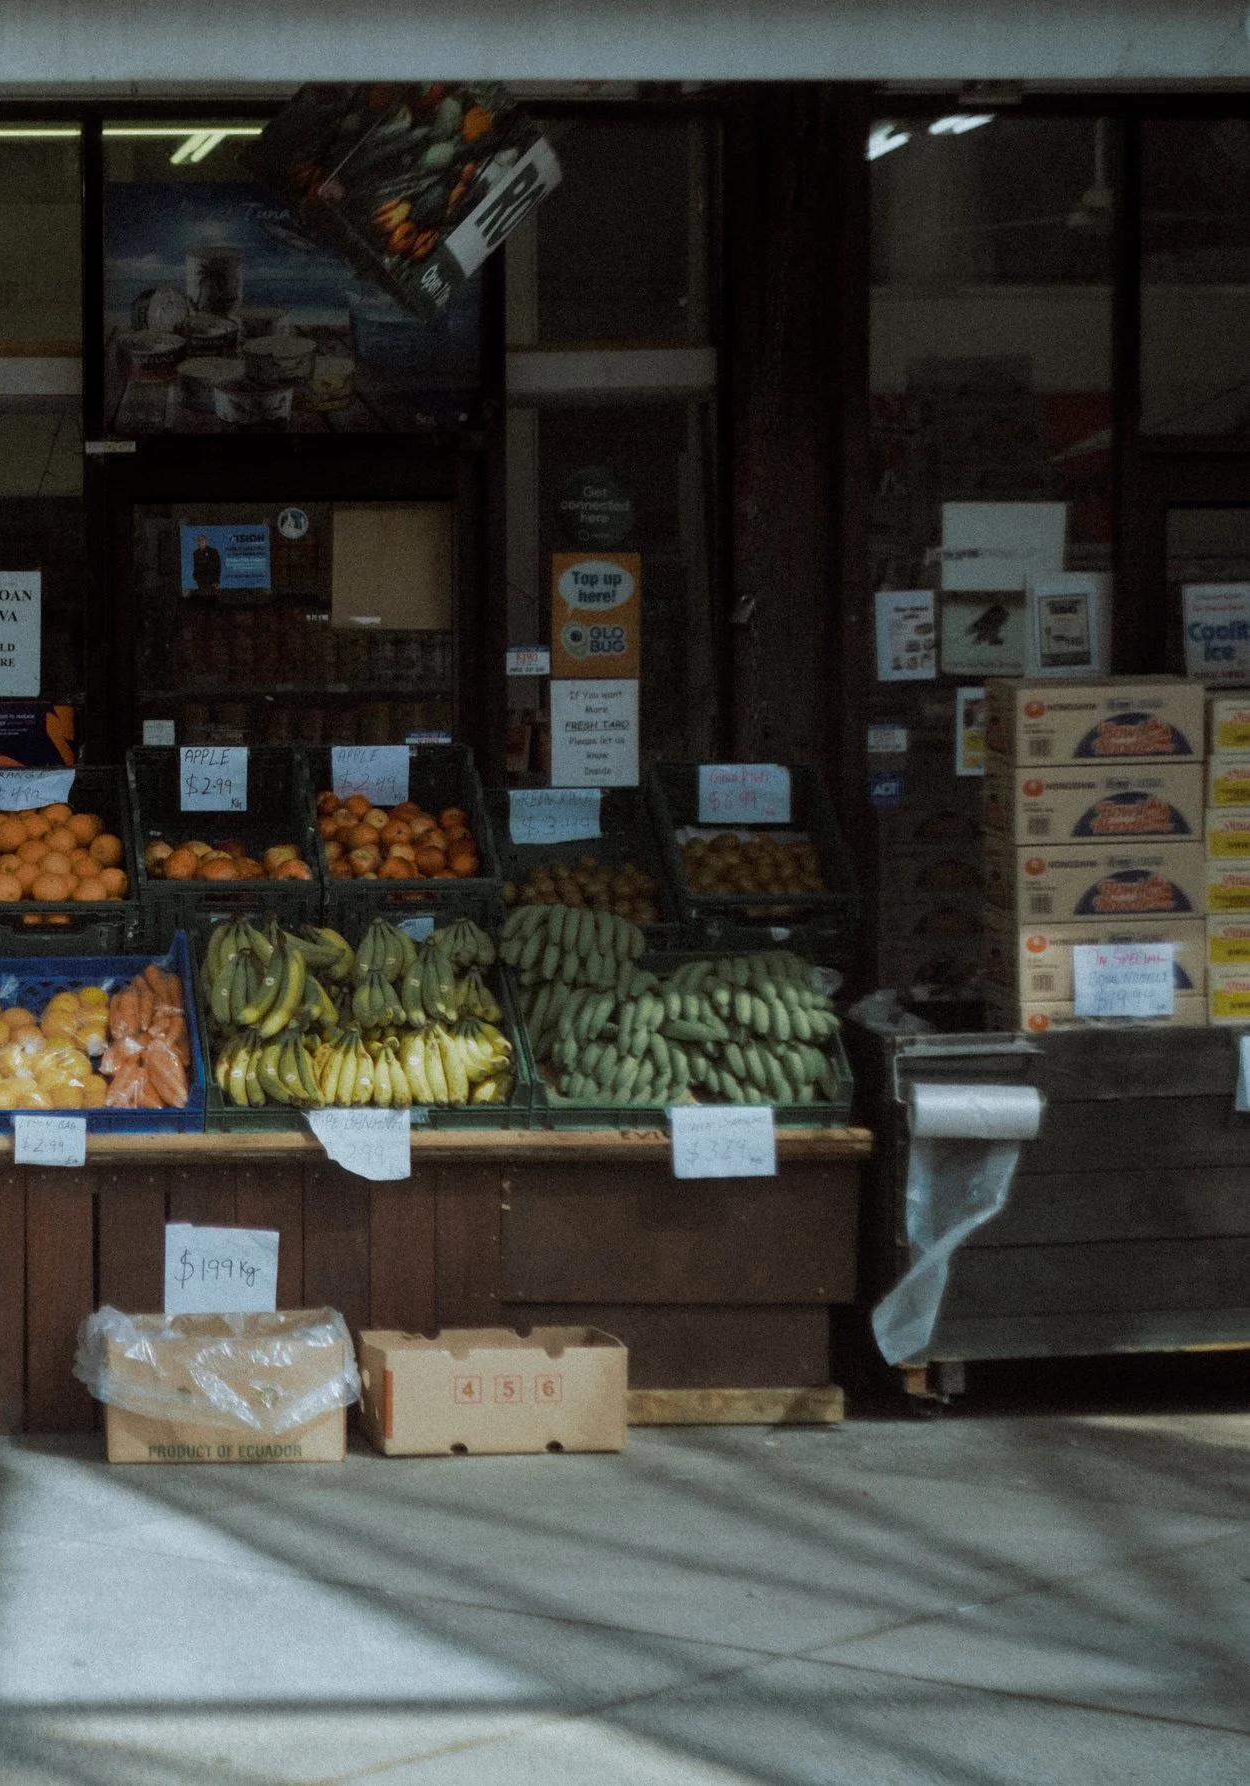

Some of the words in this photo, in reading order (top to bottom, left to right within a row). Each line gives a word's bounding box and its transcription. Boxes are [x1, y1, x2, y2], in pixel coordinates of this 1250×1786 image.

[583, 486, 607, 497] Get
[560, 500, 630, 511] connected
[580, 513, 610, 524] here
[572, 571, 598, 586] Top
[604, 574, 622, 586] up
[578, 590, 616, 603] here!
[590, 626, 625, 639] GLO
[590, 640, 625, 653] BUG
[565, 720, 598, 730] FRESH
[601, 719, 630, 730] TARO
[185, 748, 230, 766] APPLE
[337, 748, 378, 762] APPLE
[185, 775, 233, 796] $2.99
[57, 1118, 78, 1130] BAG
[461, 1380, 475, 1399] 4
[502, 1379, 516, 1399] 5
[541, 1379, 556, 1398] 6
[148, 1443, 211, 1458] PRODUCT
[217, 1443, 232, 1458] OF
[238, 1443, 302, 1458] ECUADOR
